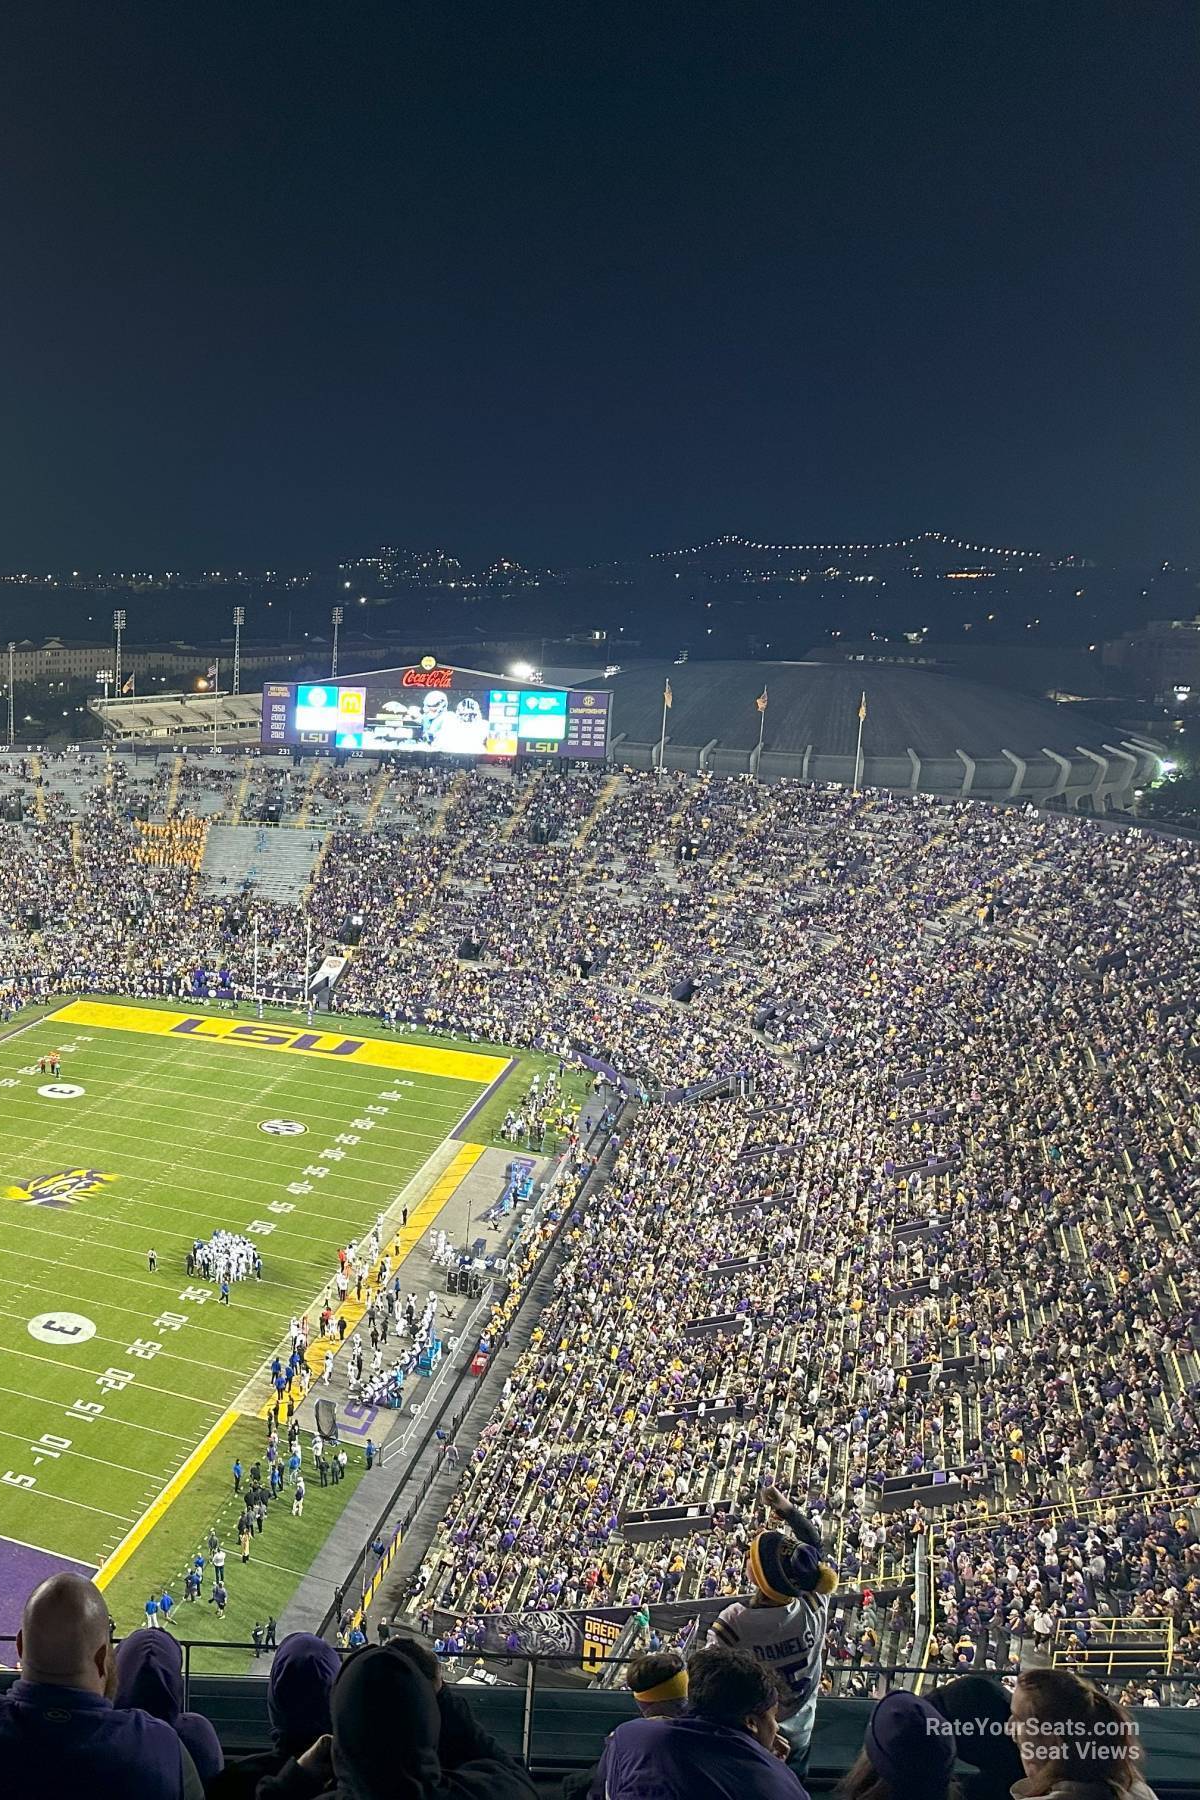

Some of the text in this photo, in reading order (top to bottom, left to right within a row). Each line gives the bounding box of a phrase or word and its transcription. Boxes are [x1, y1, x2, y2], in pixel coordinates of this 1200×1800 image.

[402, 669, 454, 688] Coca-Cola
[569, 707, 607, 716] CHAMPIONSHIPS
[270, 722, 286, 730] 2007
[300, 732, 329, 743] LSU
[278, 748, 291, 756] 231
[351, 750, 364, 758] 232
[525, 741, 559, 753] LSU
[1127, 827, 1142, 838] 241
[168, 1018, 367, 1055] LSU
[393, 1078, 415, 1087] 5
[302, 1165, 330, 1178] 35
[267, 1200, 297, 1214] 45
[246, 1219, 278, 1236] 50
[178, 1285, 214, 1305] 35
[152, 1310, 189, 1332] 30
[125, 1338, 163, 1361] 25
[96, 1367, 136, 1391] 20
[64, 1399, 106, 1423] 15
[30, 1433, 73, 1459] 10
[1, 1470, 37, 1488] 5
[753, 1630, 815, 1662] DANIELS
